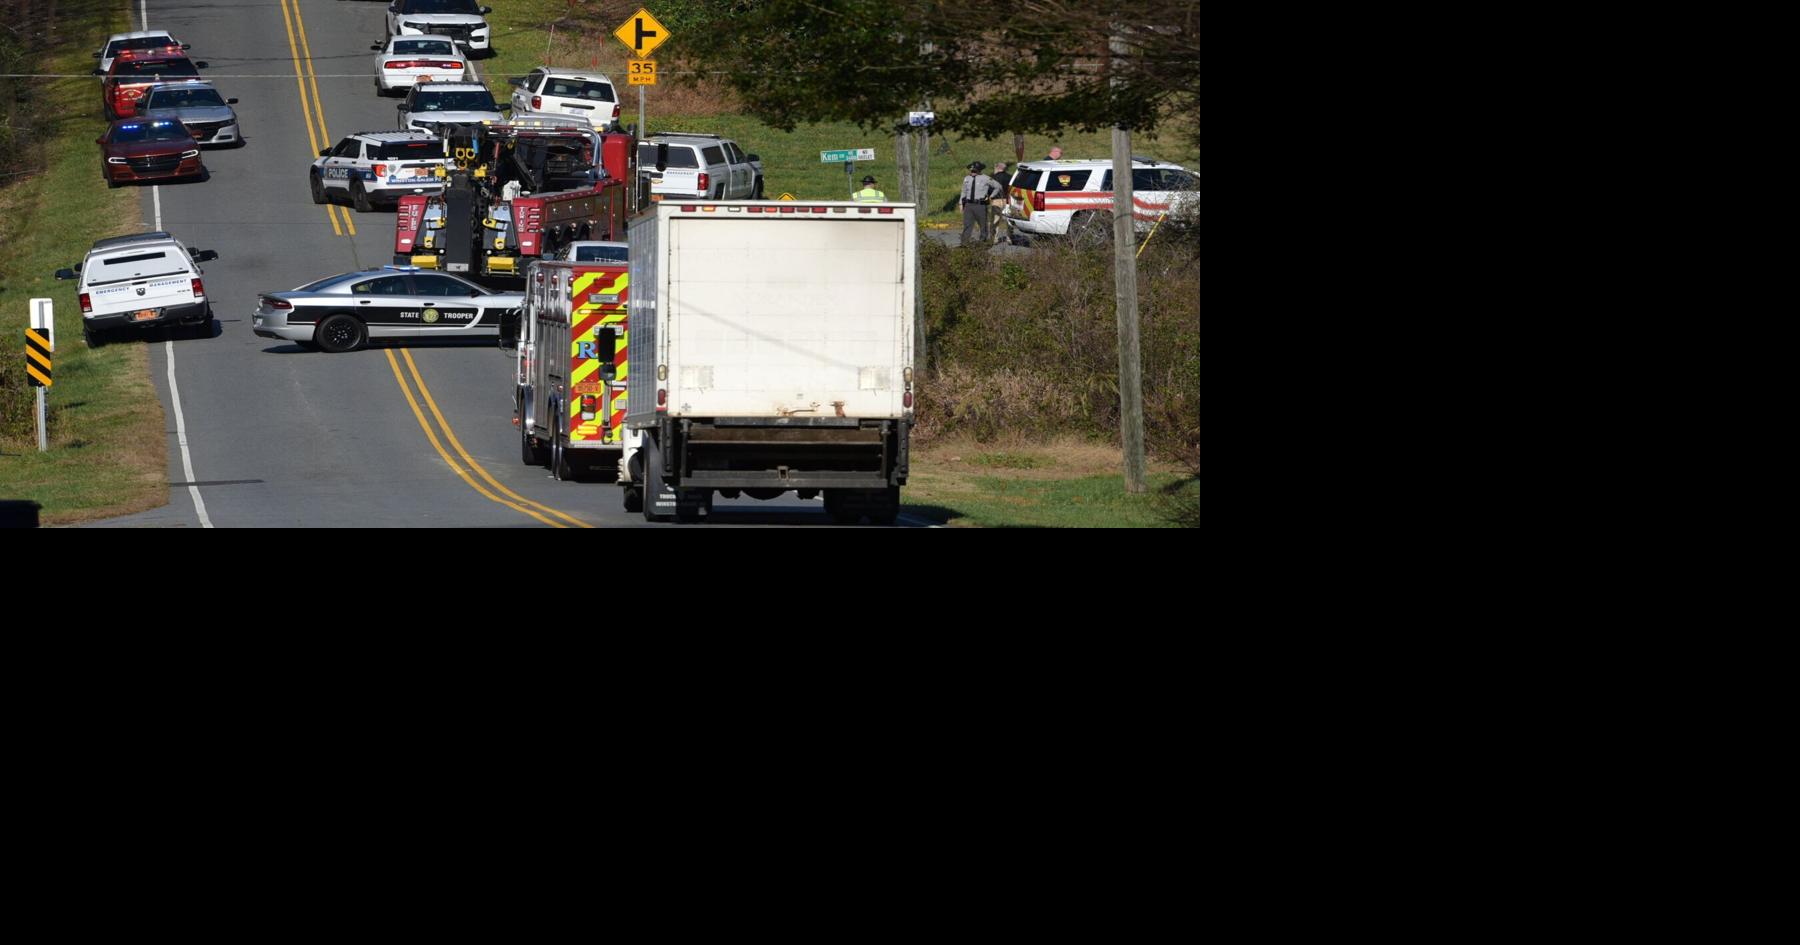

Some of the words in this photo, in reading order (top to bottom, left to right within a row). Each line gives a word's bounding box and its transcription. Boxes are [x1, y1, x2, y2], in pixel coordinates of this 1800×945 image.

[631, 63, 653, 74] 35
[328, 168, 349, 178] POLICE
[96, 287, 130, 295] EMERGENCY
[149, 279, 187, 288] MANAGEMENT
